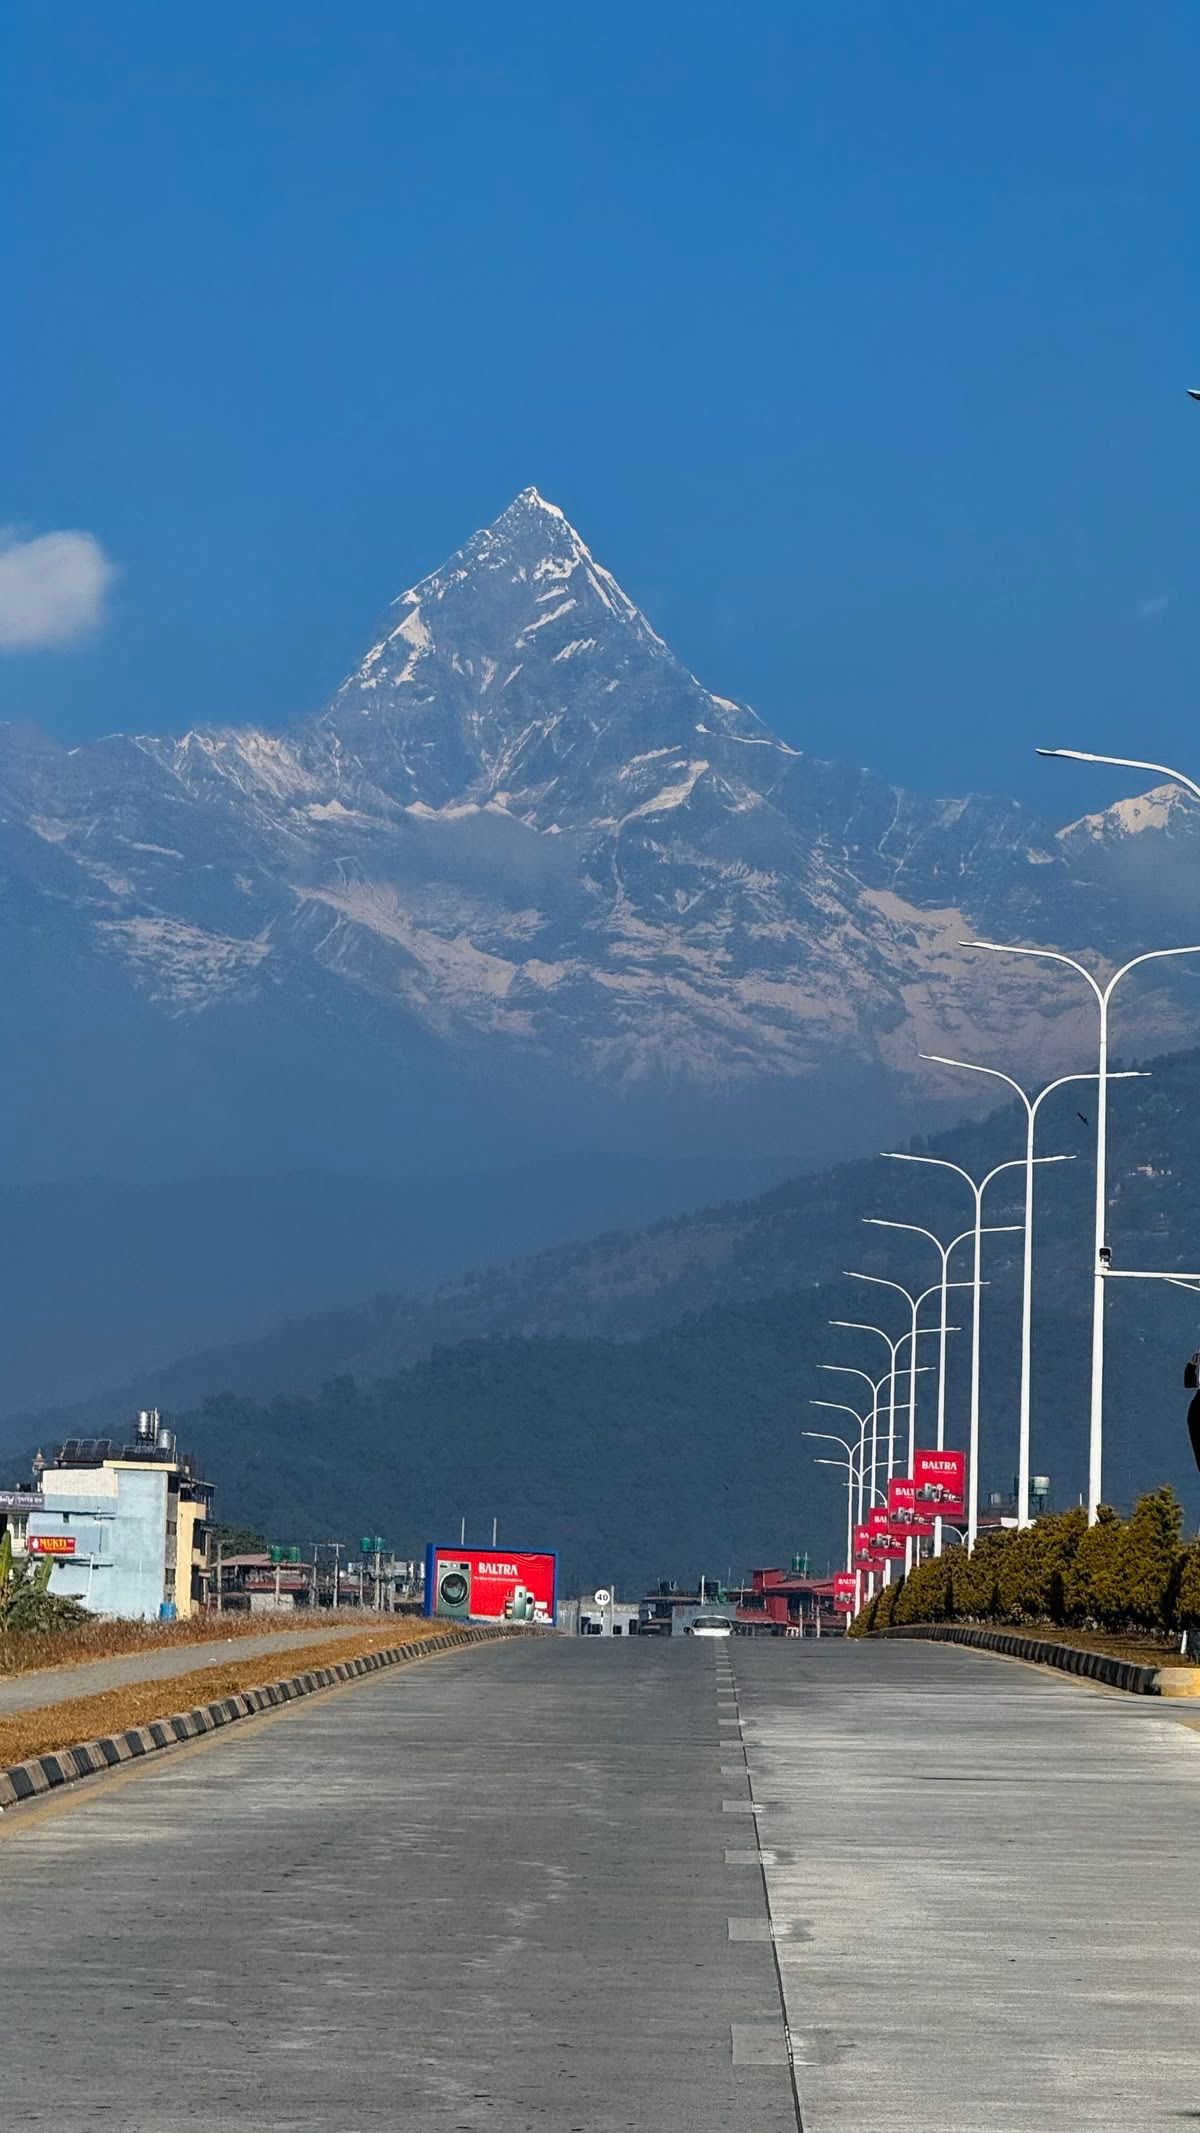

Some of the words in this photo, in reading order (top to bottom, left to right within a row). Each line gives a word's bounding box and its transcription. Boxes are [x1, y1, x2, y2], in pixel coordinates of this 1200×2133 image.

[921, 1460, 958, 1471] BALTRA
[895, 1487, 915, 1496] BALT
[478, 1562, 518, 1576] BALTRA
[597, 1593, 609, 1601] 40
